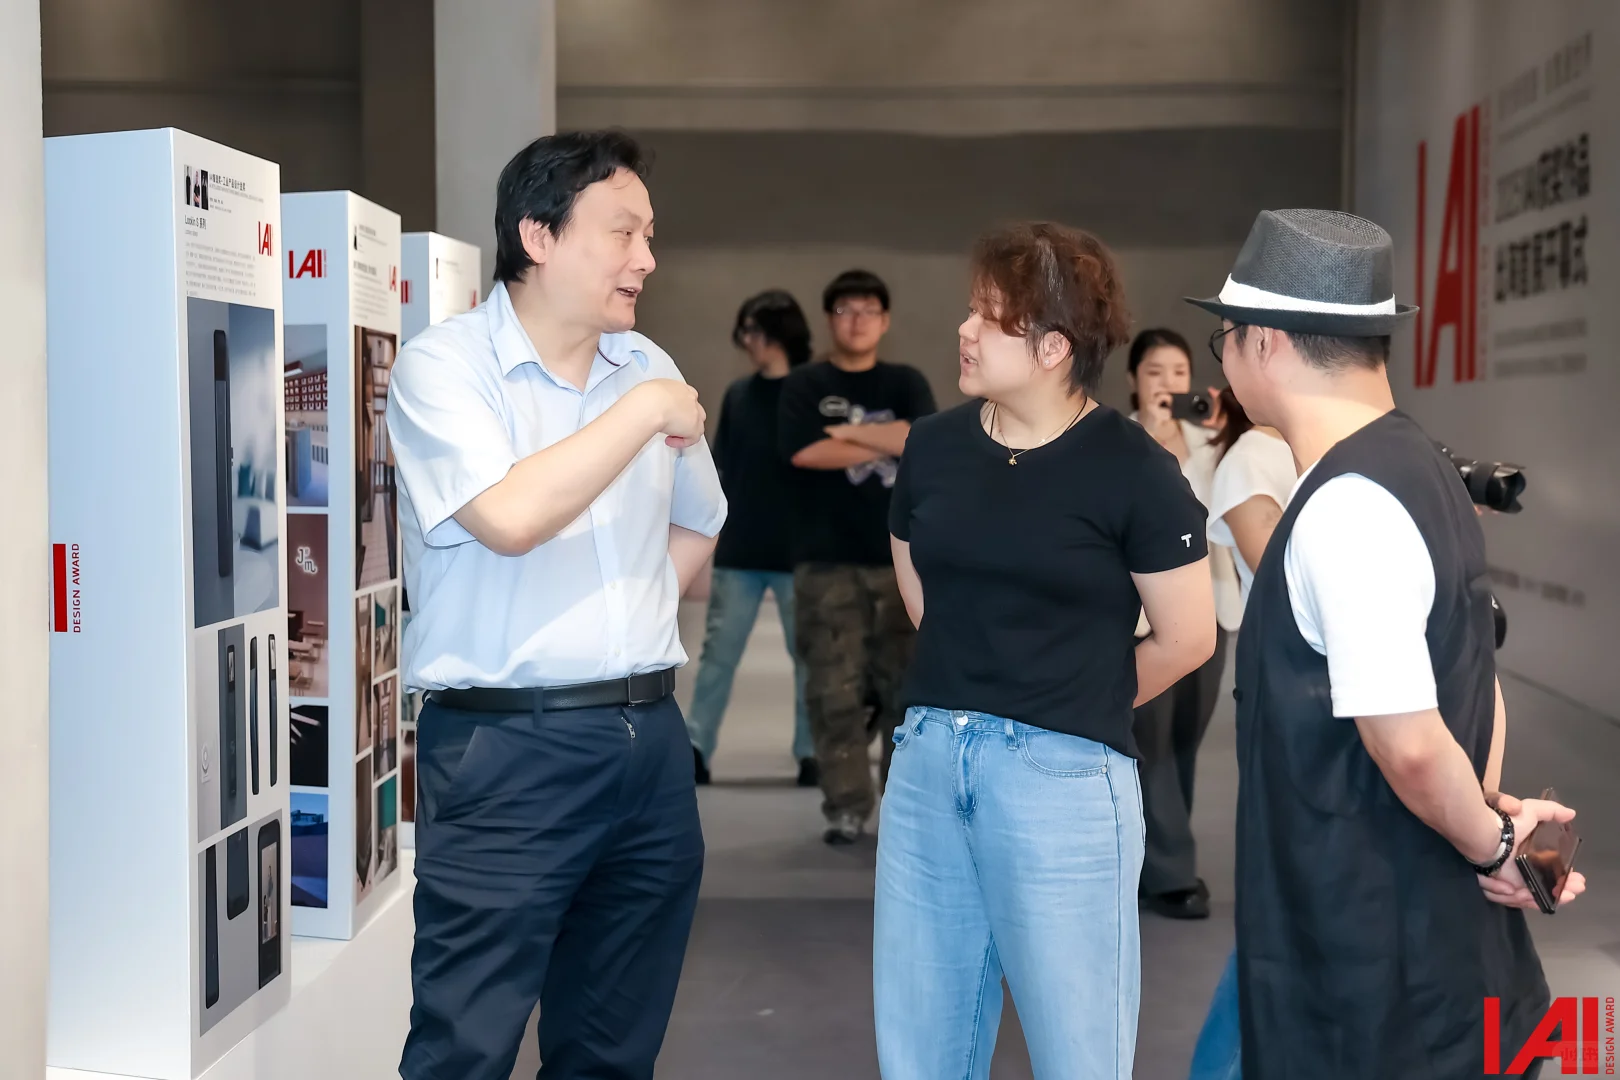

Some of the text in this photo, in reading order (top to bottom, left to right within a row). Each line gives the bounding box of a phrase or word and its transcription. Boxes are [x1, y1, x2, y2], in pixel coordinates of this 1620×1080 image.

[258, 220, 272, 257] IAI
[1414, 104, 1480, 389] IAI
[289, 249, 322, 279] IAI
[1181, 533, 1192, 548] T
[72, 543, 81, 633] DESIGN AWARD
